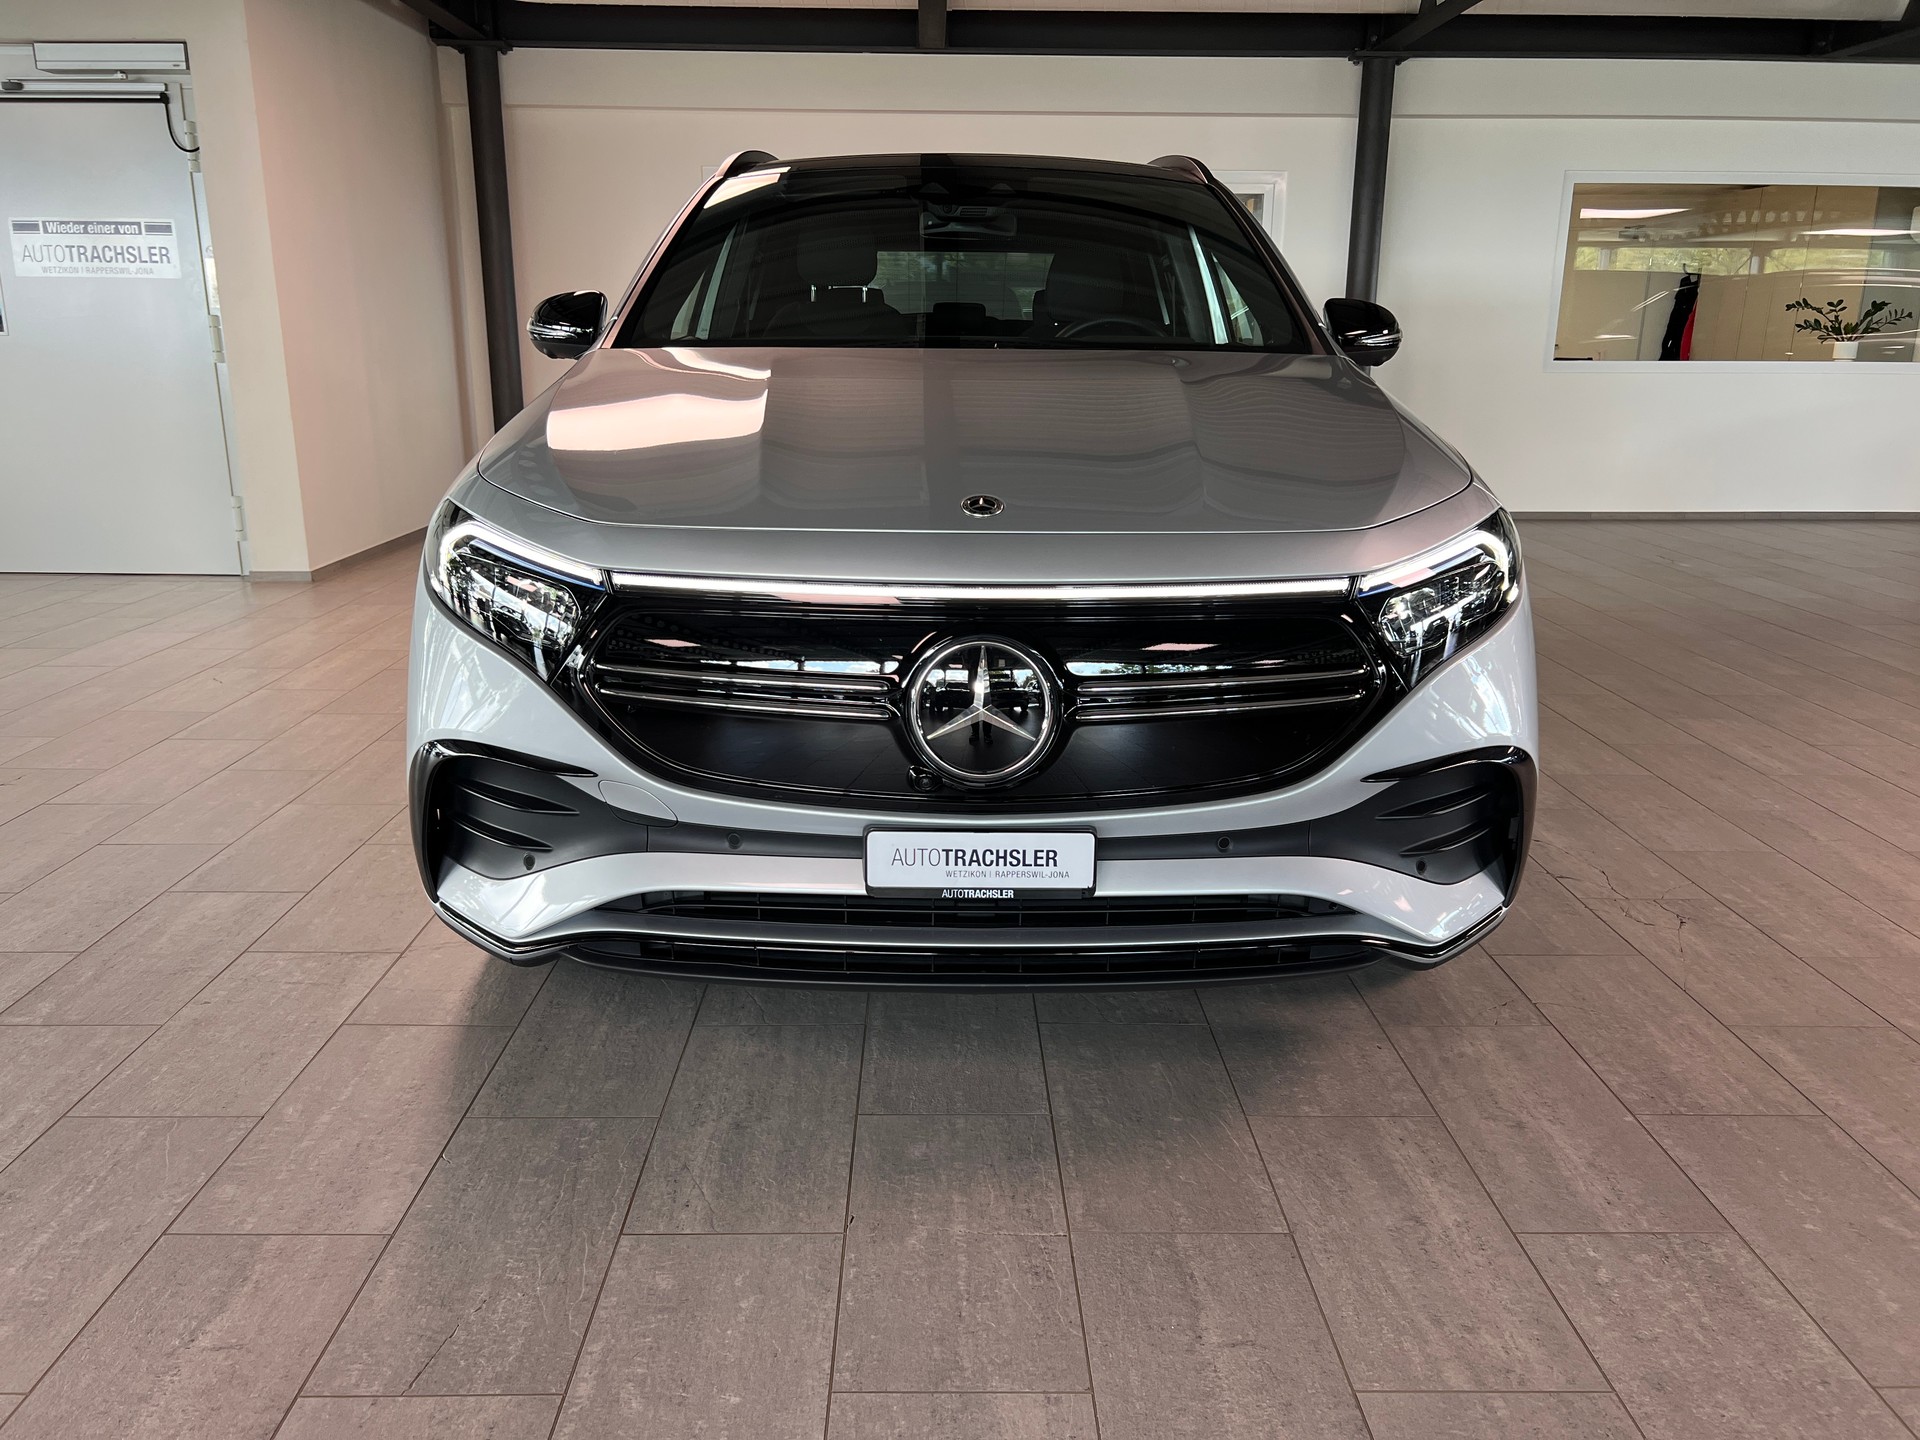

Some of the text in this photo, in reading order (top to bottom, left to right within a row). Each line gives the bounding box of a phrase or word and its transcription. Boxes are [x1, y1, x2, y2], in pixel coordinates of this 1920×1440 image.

[45, 222, 139, 235] Wieder einer von
[22, 245, 171, 264] AUTOTRACHSLER
[42, 266, 154, 275] WETZIKON RAPPERSWIL-JONA
[891, 848, 1058, 867] AUTOTRACHSLER
[945, 870, 1070, 879] WETZIKON RAPPERSWIL-JONA
[941, 888, 1014, 899] AUTOTRACHSLER
